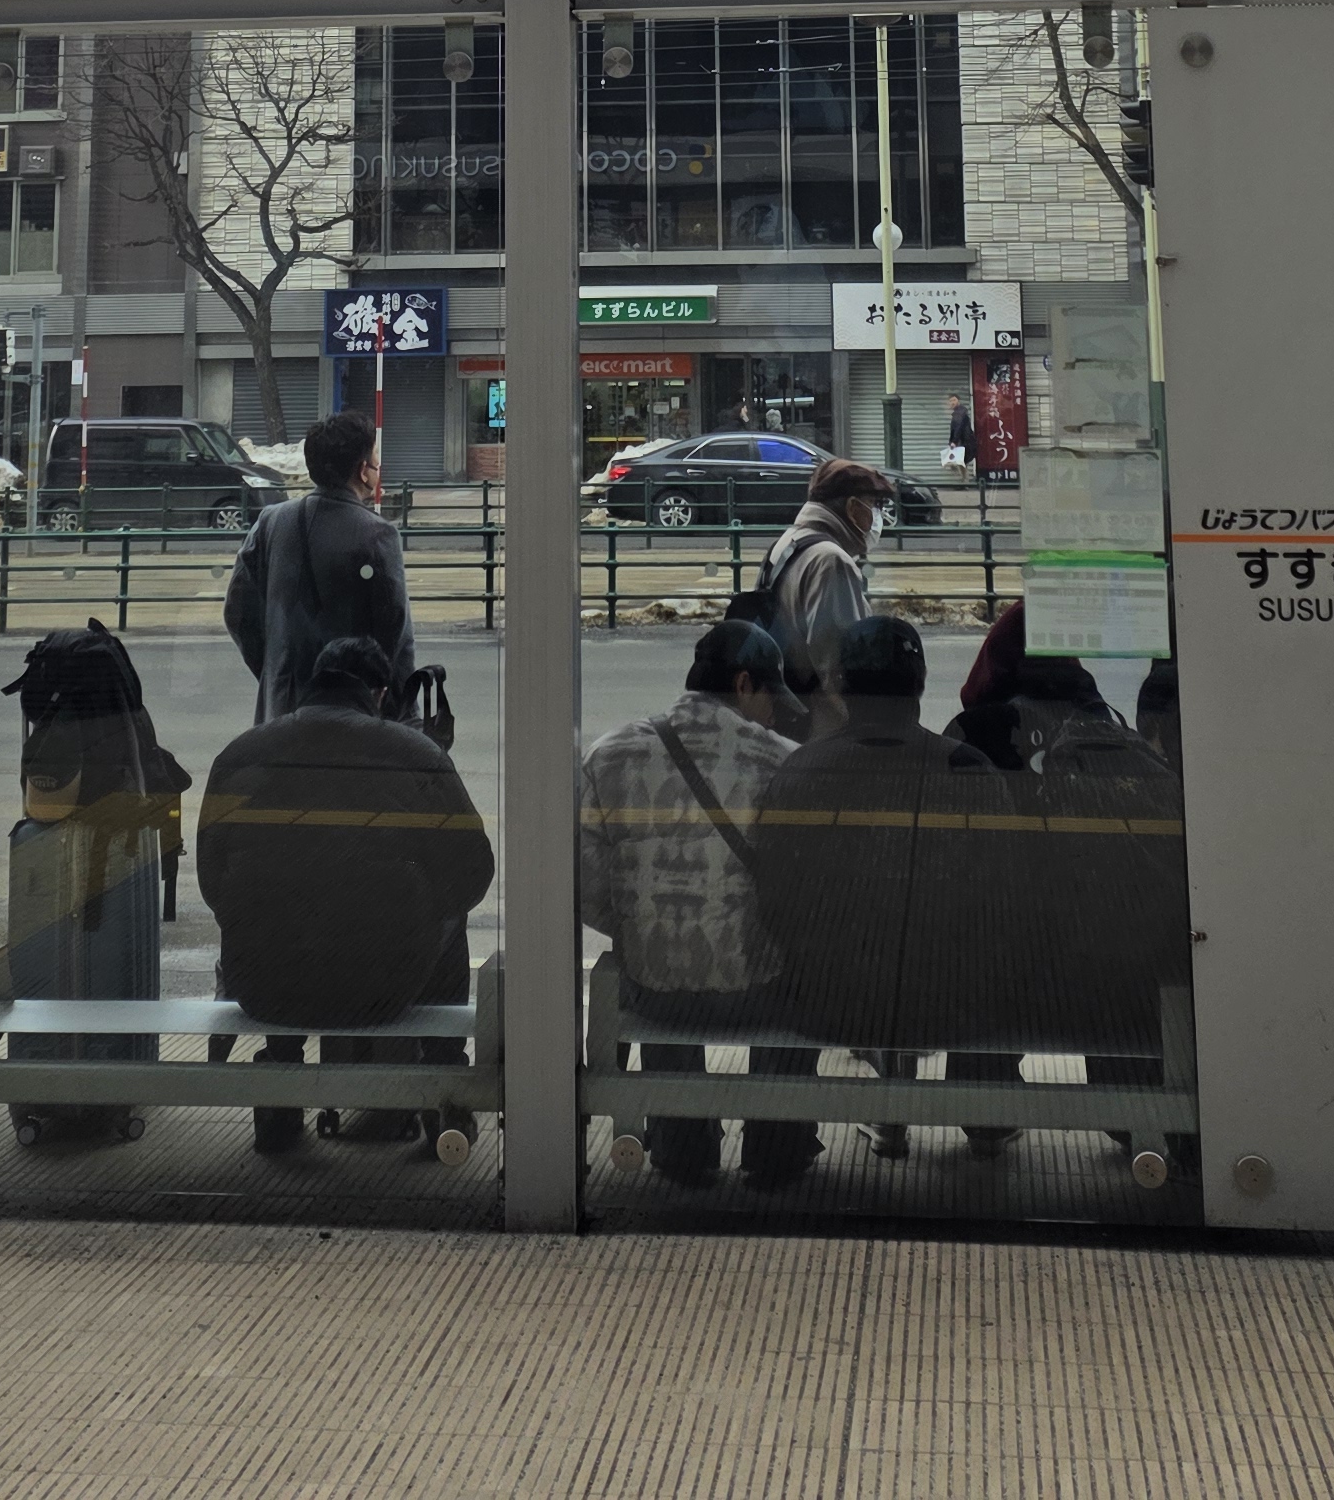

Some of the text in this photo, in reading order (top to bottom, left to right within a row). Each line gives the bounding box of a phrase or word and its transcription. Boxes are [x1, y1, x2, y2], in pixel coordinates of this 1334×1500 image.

[592, 301, 693, 318] すずらんビル
[580, 356, 673, 374] eicomart
[989, 419, 1013, 462] ふう
